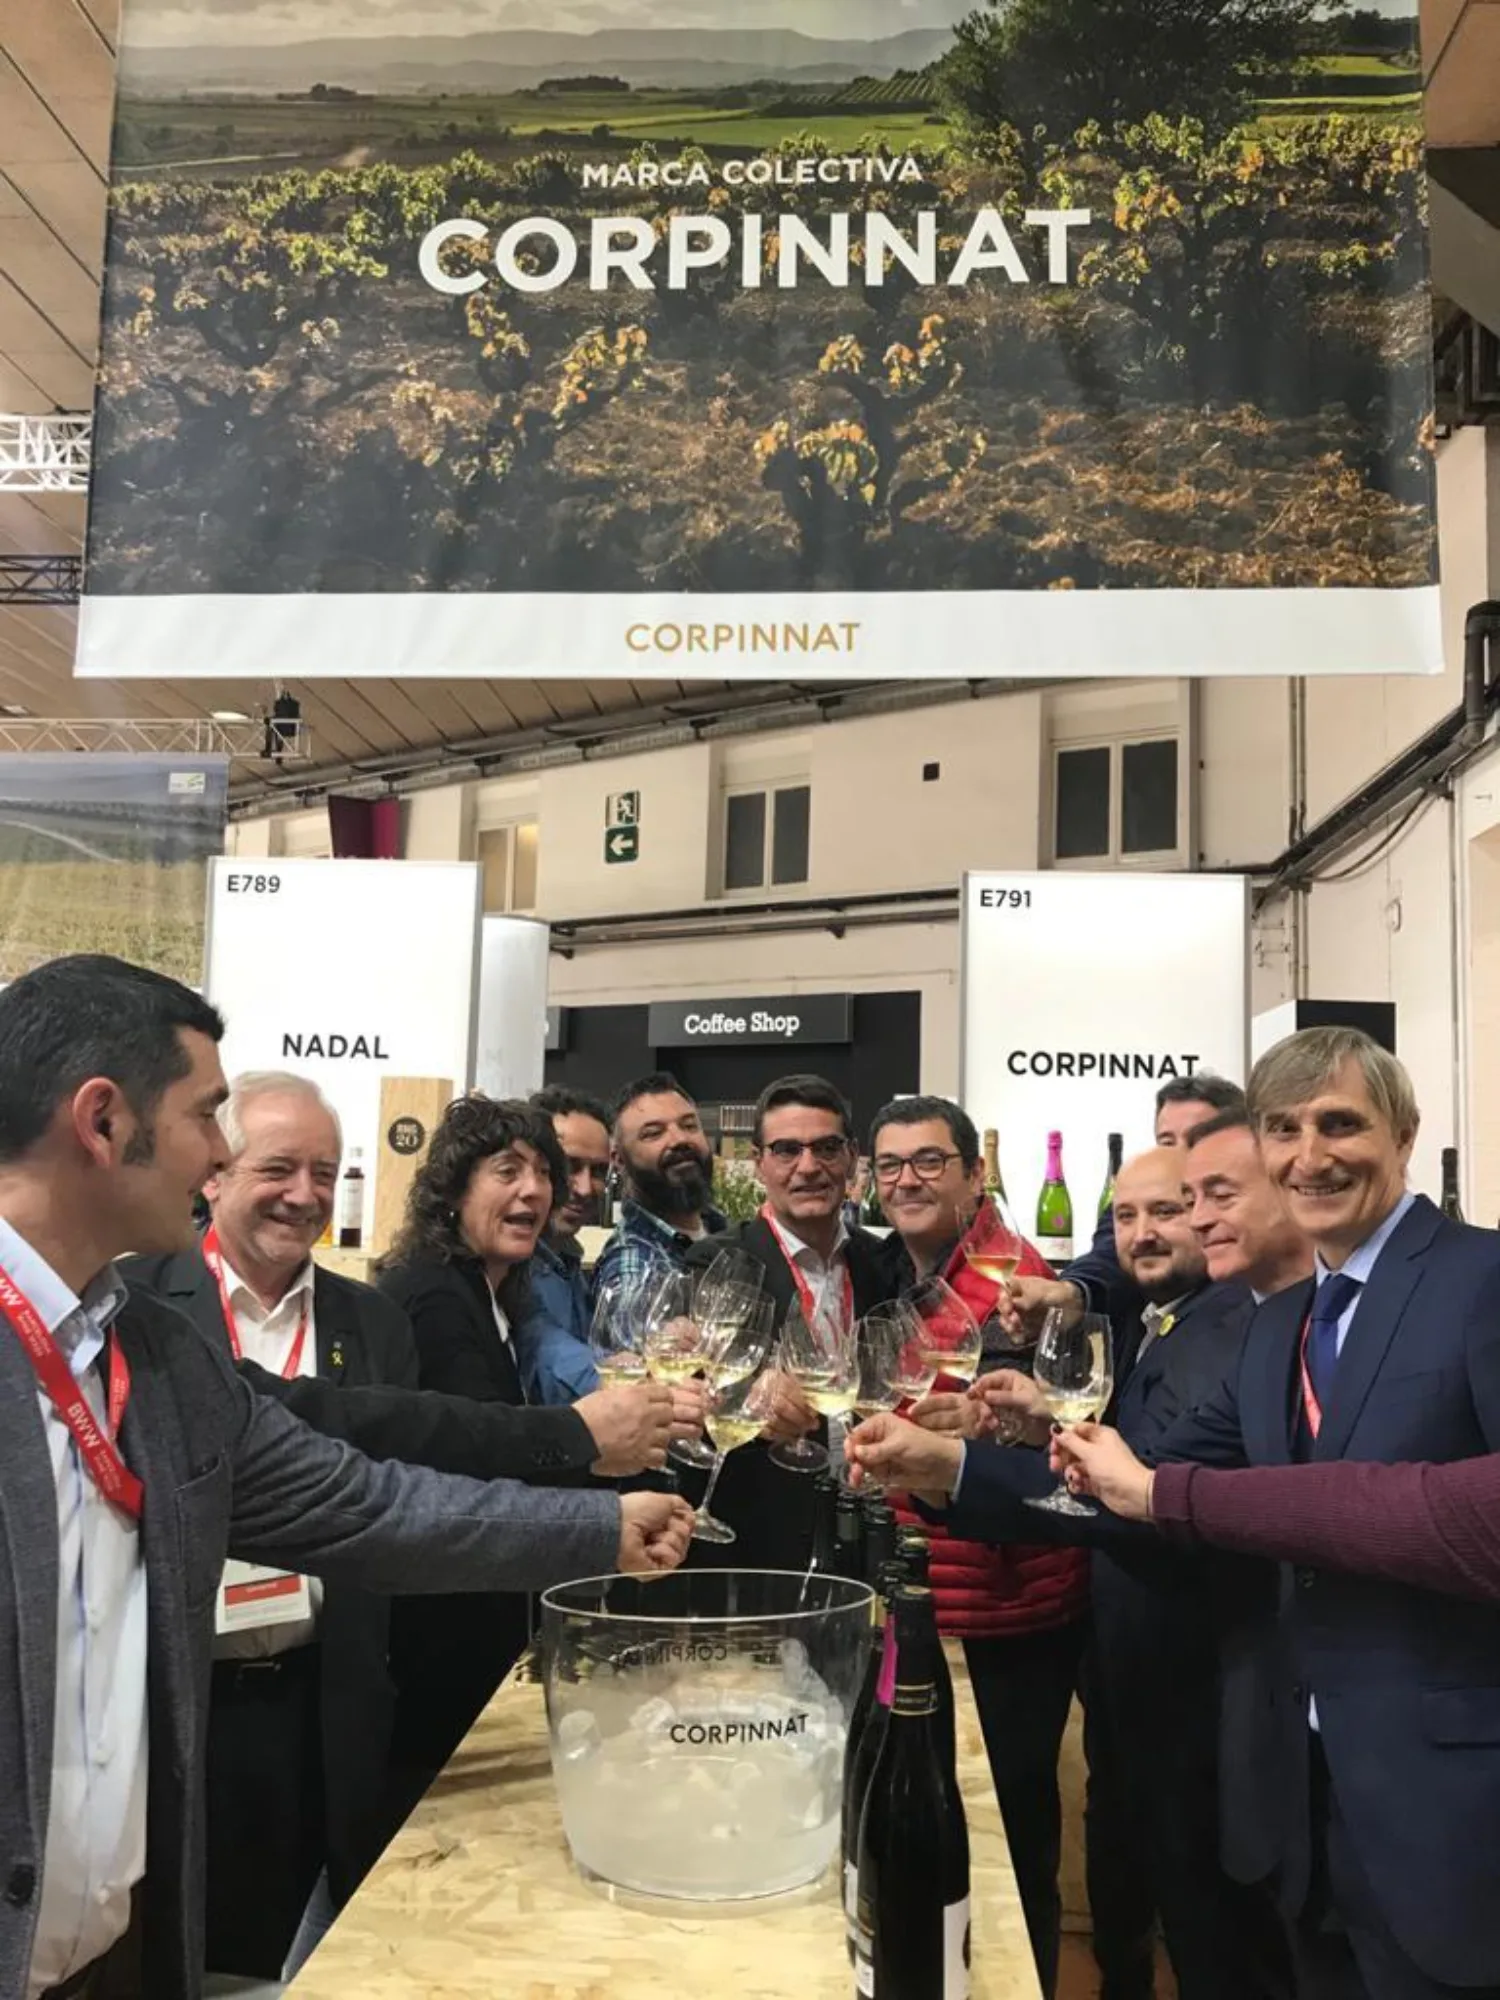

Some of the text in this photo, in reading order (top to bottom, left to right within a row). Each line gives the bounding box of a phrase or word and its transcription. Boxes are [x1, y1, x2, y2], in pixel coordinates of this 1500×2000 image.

[582, 157, 923, 188] MARCA COLECTIVA
[418, 207, 1093, 295] CORPINNAT
[625, 622, 862, 653] CORPINNAT
[227, 874, 281, 893] E789
[980, 888, 1032, 909] E791
[684, 1011, 800, 1037] Coffee Shop
[282, 1032, 390, 1060] NADAL
[1007, 1050, 1200, 1079] CORPINNAT
[67, 1401, 101, 1448] BWW
[669, 1713, 809, 1745] CORPINNAT
